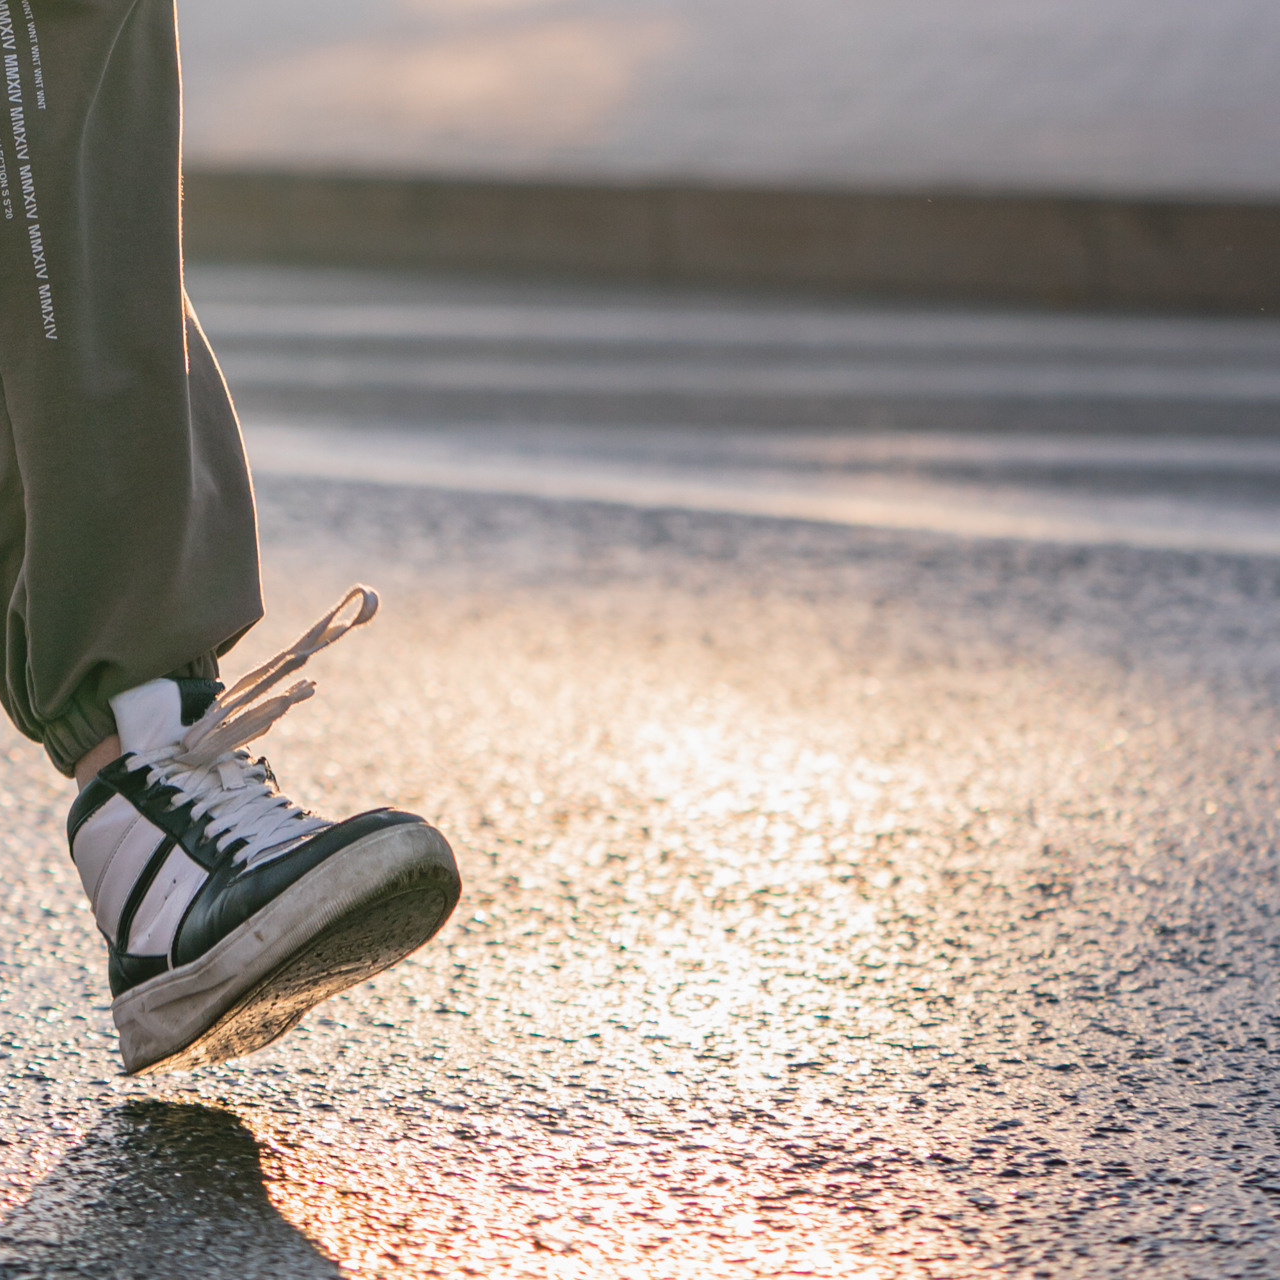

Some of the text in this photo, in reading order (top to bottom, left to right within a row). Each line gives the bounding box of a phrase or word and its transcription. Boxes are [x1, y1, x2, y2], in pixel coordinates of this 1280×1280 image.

[27, 22, 38, 43] WNT
[30, 44, 41, 66] WNT
[3, 53, 23, 103] MMXIV
[33, 67, 44, 88] WNT
[36, 89, 46, 110] WNT
[10, 106, 30, 160] MMXIV
[19, 164, 39, 219] MMXIV
[27, 224, 49, 279] MMXIV
[37, 284, 58, 340] MMXIV
